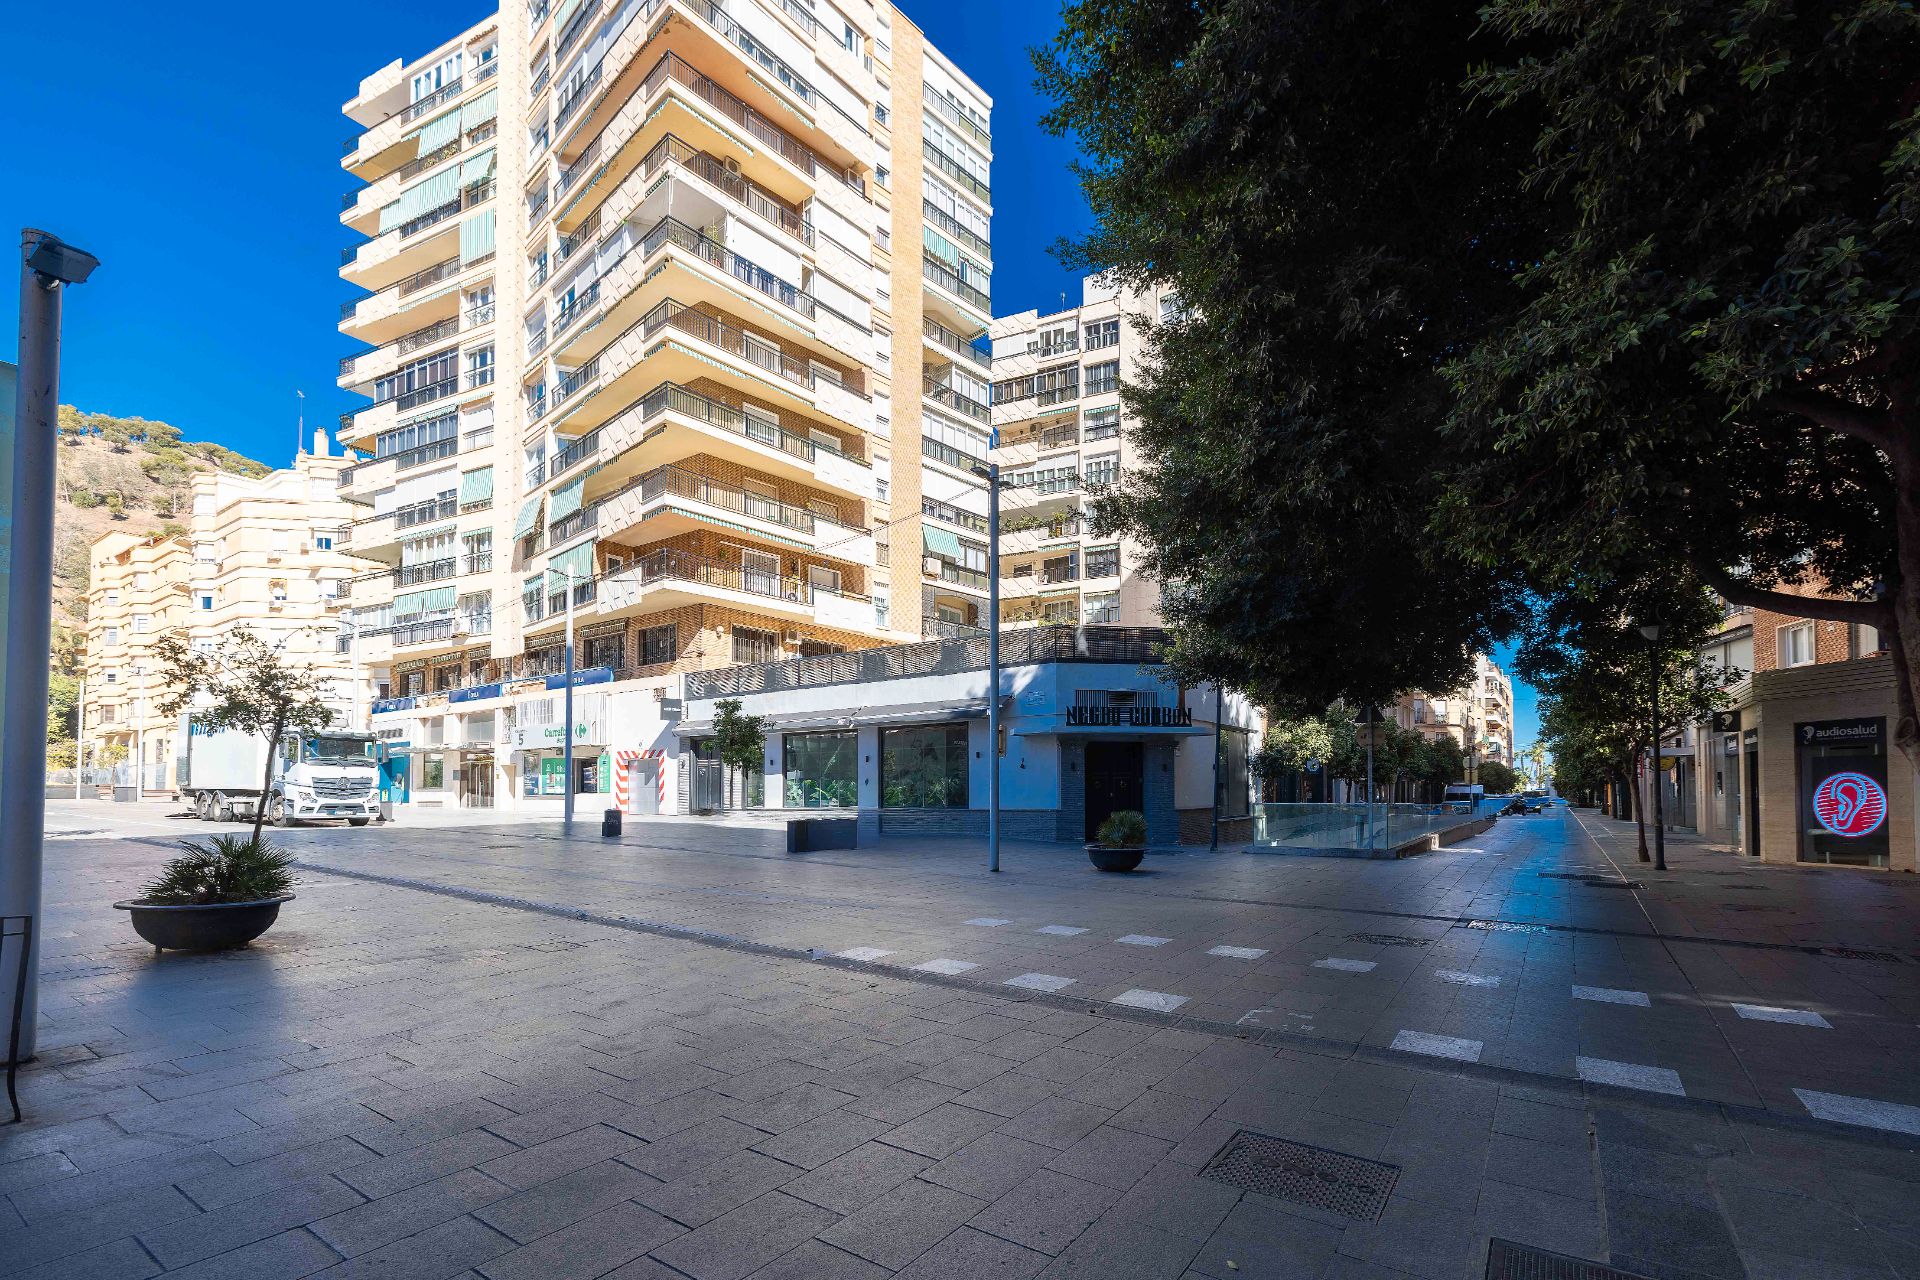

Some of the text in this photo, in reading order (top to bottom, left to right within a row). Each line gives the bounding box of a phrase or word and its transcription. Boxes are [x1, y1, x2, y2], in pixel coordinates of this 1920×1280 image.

[544, 726, 566, 738] Carrefo
[1816, 724, 1877, 737] audiosalud
[518, 733, 524, 745] 5
